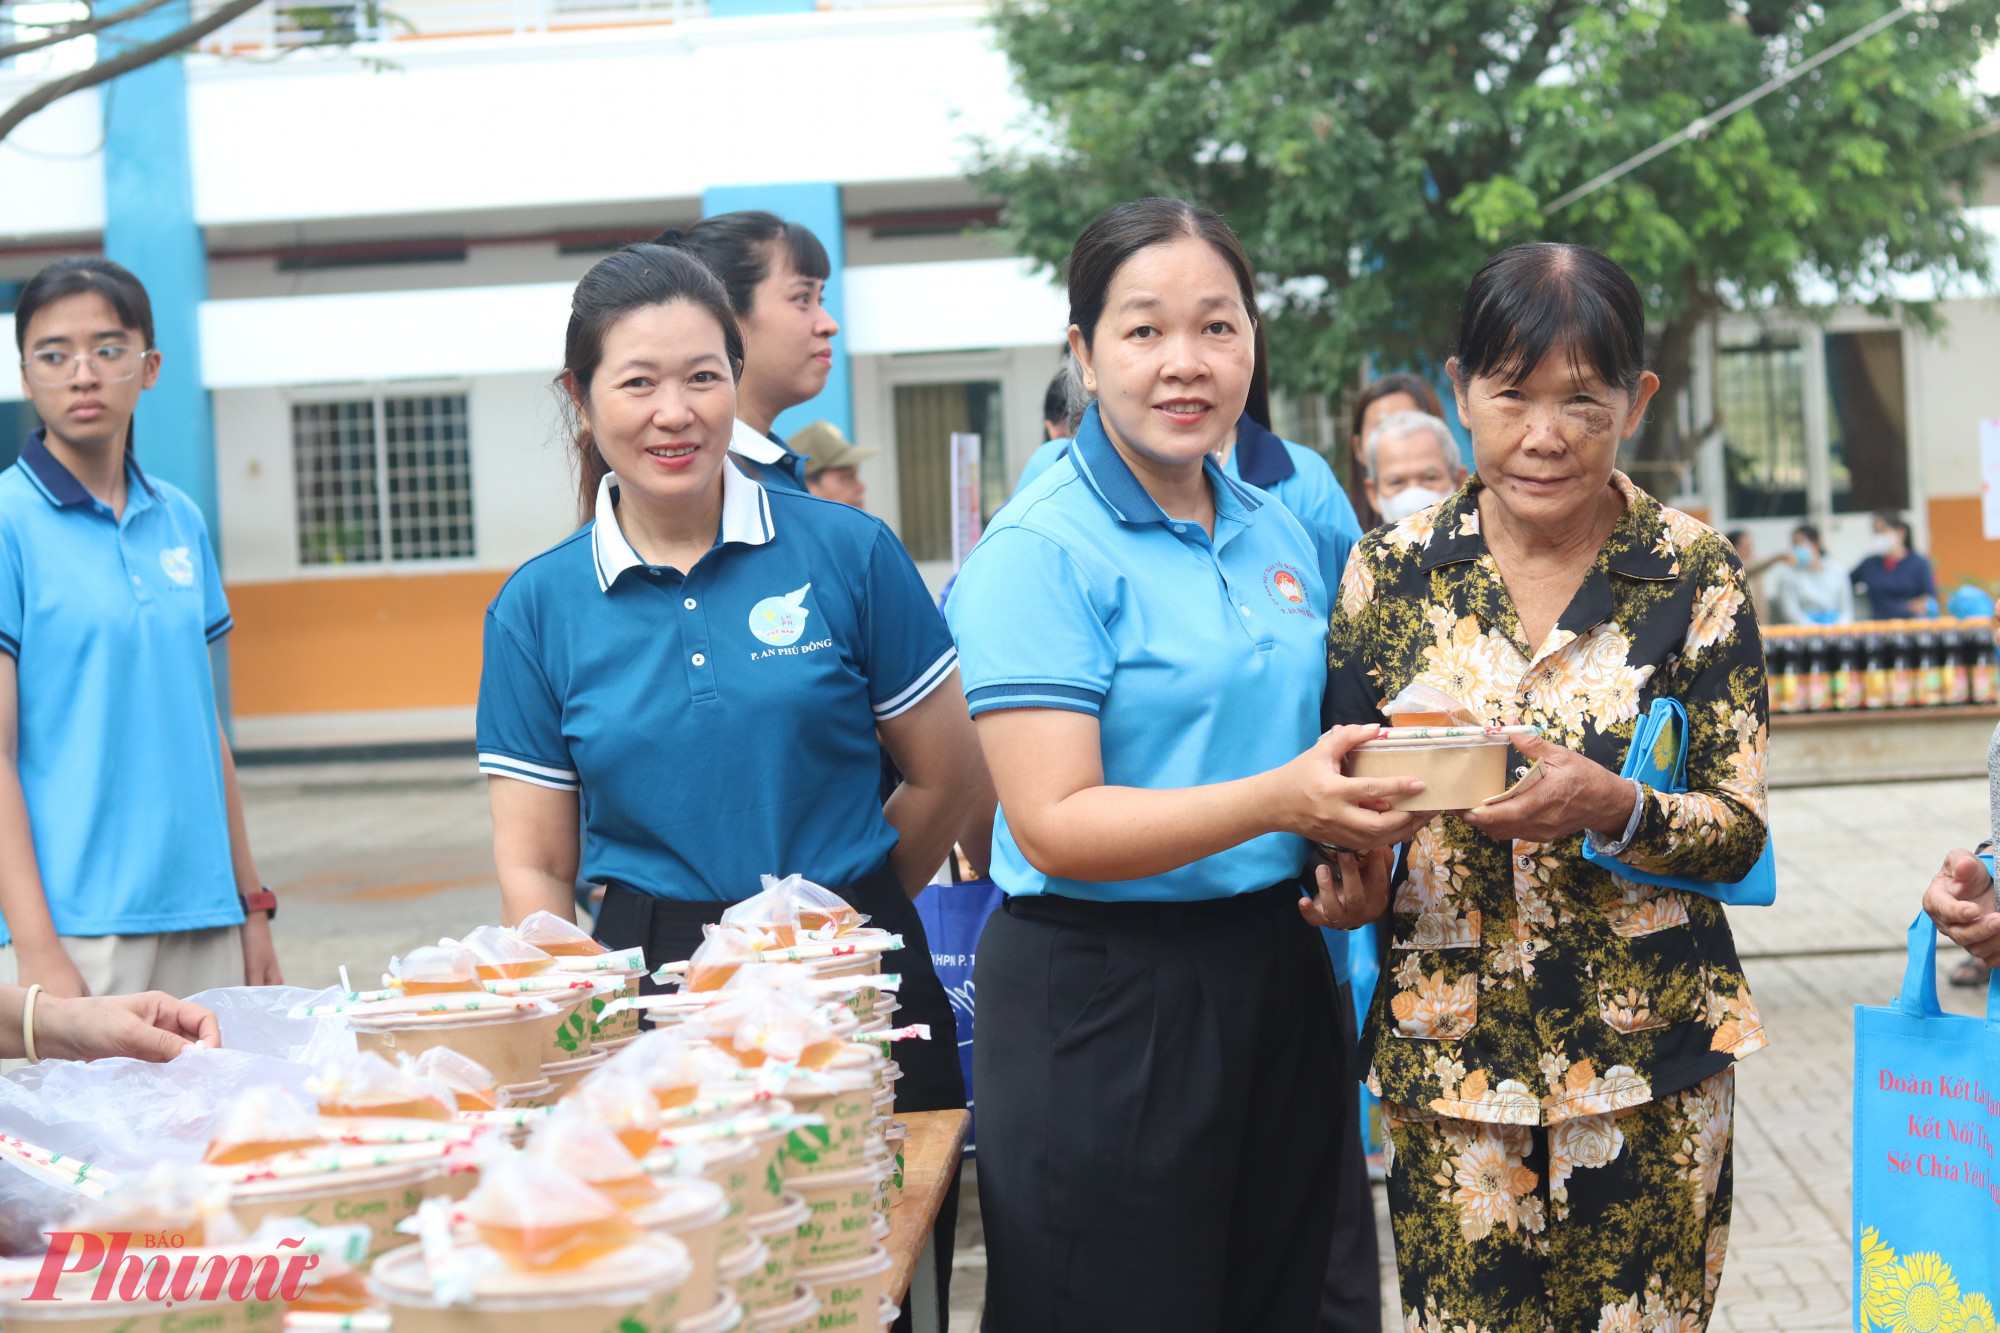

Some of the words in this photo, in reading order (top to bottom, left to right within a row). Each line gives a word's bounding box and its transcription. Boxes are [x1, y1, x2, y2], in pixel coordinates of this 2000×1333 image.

[751, 652, 759, 661] P.
[761, 649, 776, 658] AN
[778, 646, 799, 656] PHÚ
[801, 638, 832, 654] ĐÔNG
[1878, 1069, 1933, 1095] Đoàn
[1940, 1075, 1970, 1100] Kết
[1908, 1114, 1942, 1140] Kết
[1947, 1119, 1975, 1145] Nối
[1917, 1153, 1959, 1182] Chia
[1964, 1161, 1985, 1188] Yêu
